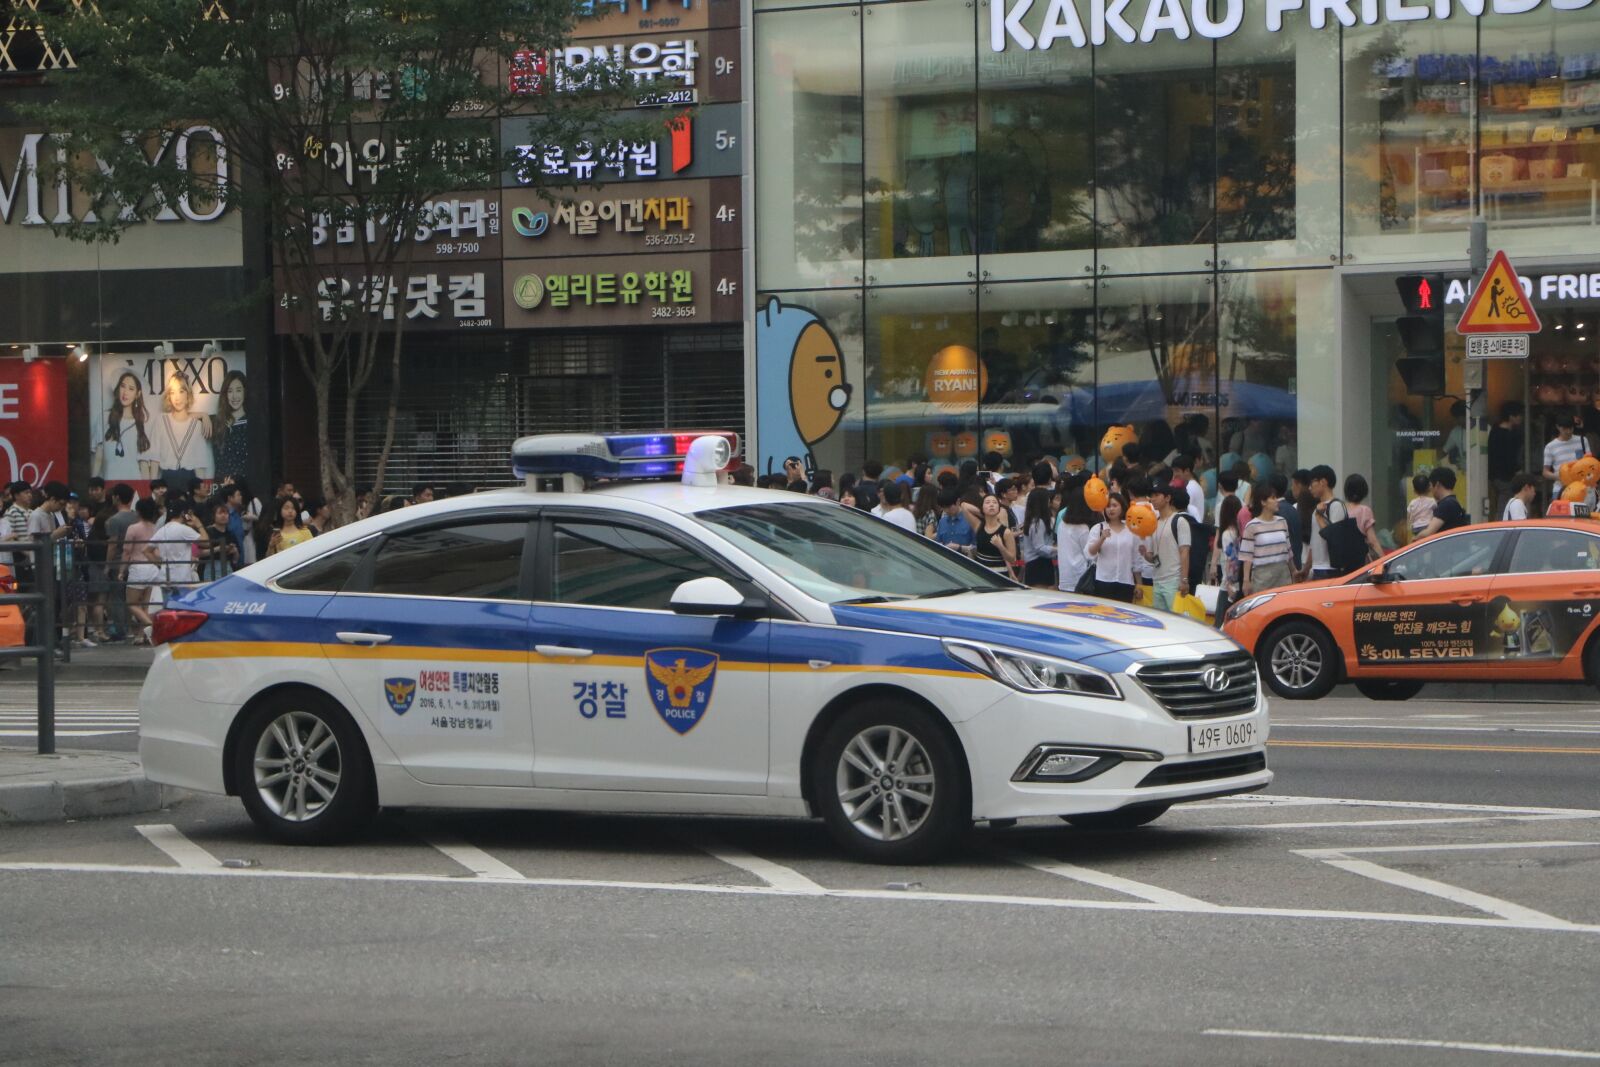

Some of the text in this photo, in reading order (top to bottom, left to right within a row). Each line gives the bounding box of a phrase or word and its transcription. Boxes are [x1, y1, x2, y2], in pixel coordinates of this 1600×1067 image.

[991, 0, 1245, 53] KAKAO
[714, 56, 734, 76] 9F
[715, 130, 736, 150] 5F
[552, 196, 693, 235] 서울이건치과
[715, 204, 736, 222] 4F
[645, 233, 696, 246] 536-2751-2
[436, 243, 480, 254] 598-7500
[545, 270, 693, 307] 엘리트유학원
[716, 278, 737, 296] 4F
[652, 306, 696, 318] 3482-3654
[934, 378, 977, 392] RYAN!
[223, 601, 266, 615] 강남 04
[1355, 610, 1416, 622] 차의 핵심은 엔진
[1393, 622, 1424, 635] 엔진을
[1426, 621, 1458, 634] 깨우는
[1409, 647, 1474, 659] SEVEN
[419, 669, 450, 692] 여성안전
[573, 680, 628, 719] 경찰
[655, 689, 664, 701] 경
[665, 708, 696, 720] POLICE
[1226, 723, 1252, 746] 0609
